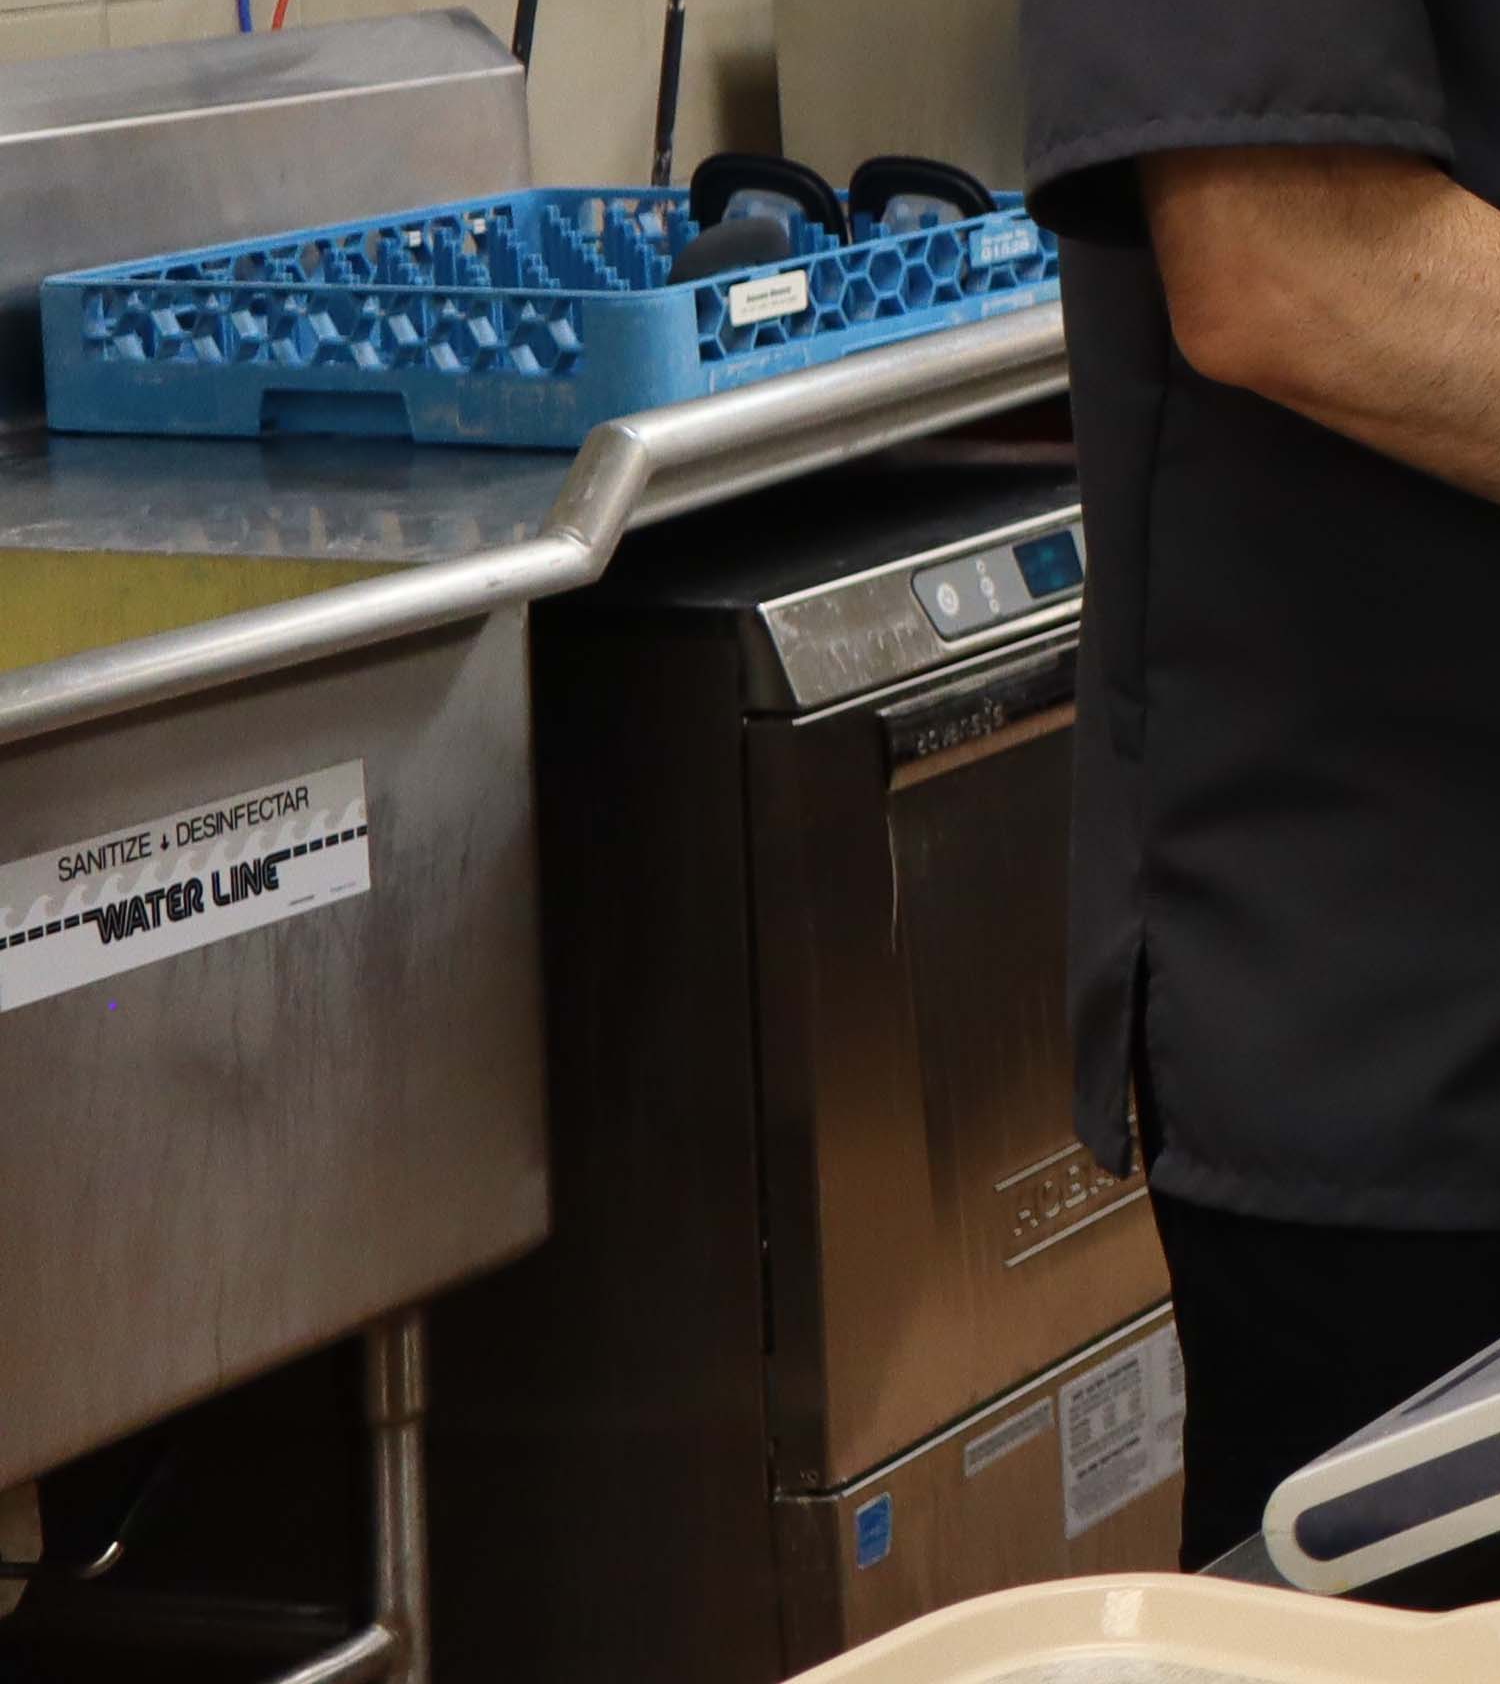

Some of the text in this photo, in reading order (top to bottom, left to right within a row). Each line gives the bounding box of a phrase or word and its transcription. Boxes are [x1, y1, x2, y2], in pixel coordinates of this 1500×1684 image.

[58, 786, 310, 883] SANITIZE DESINFECTAR
[95, 852, 281, 944] WATER LINE
